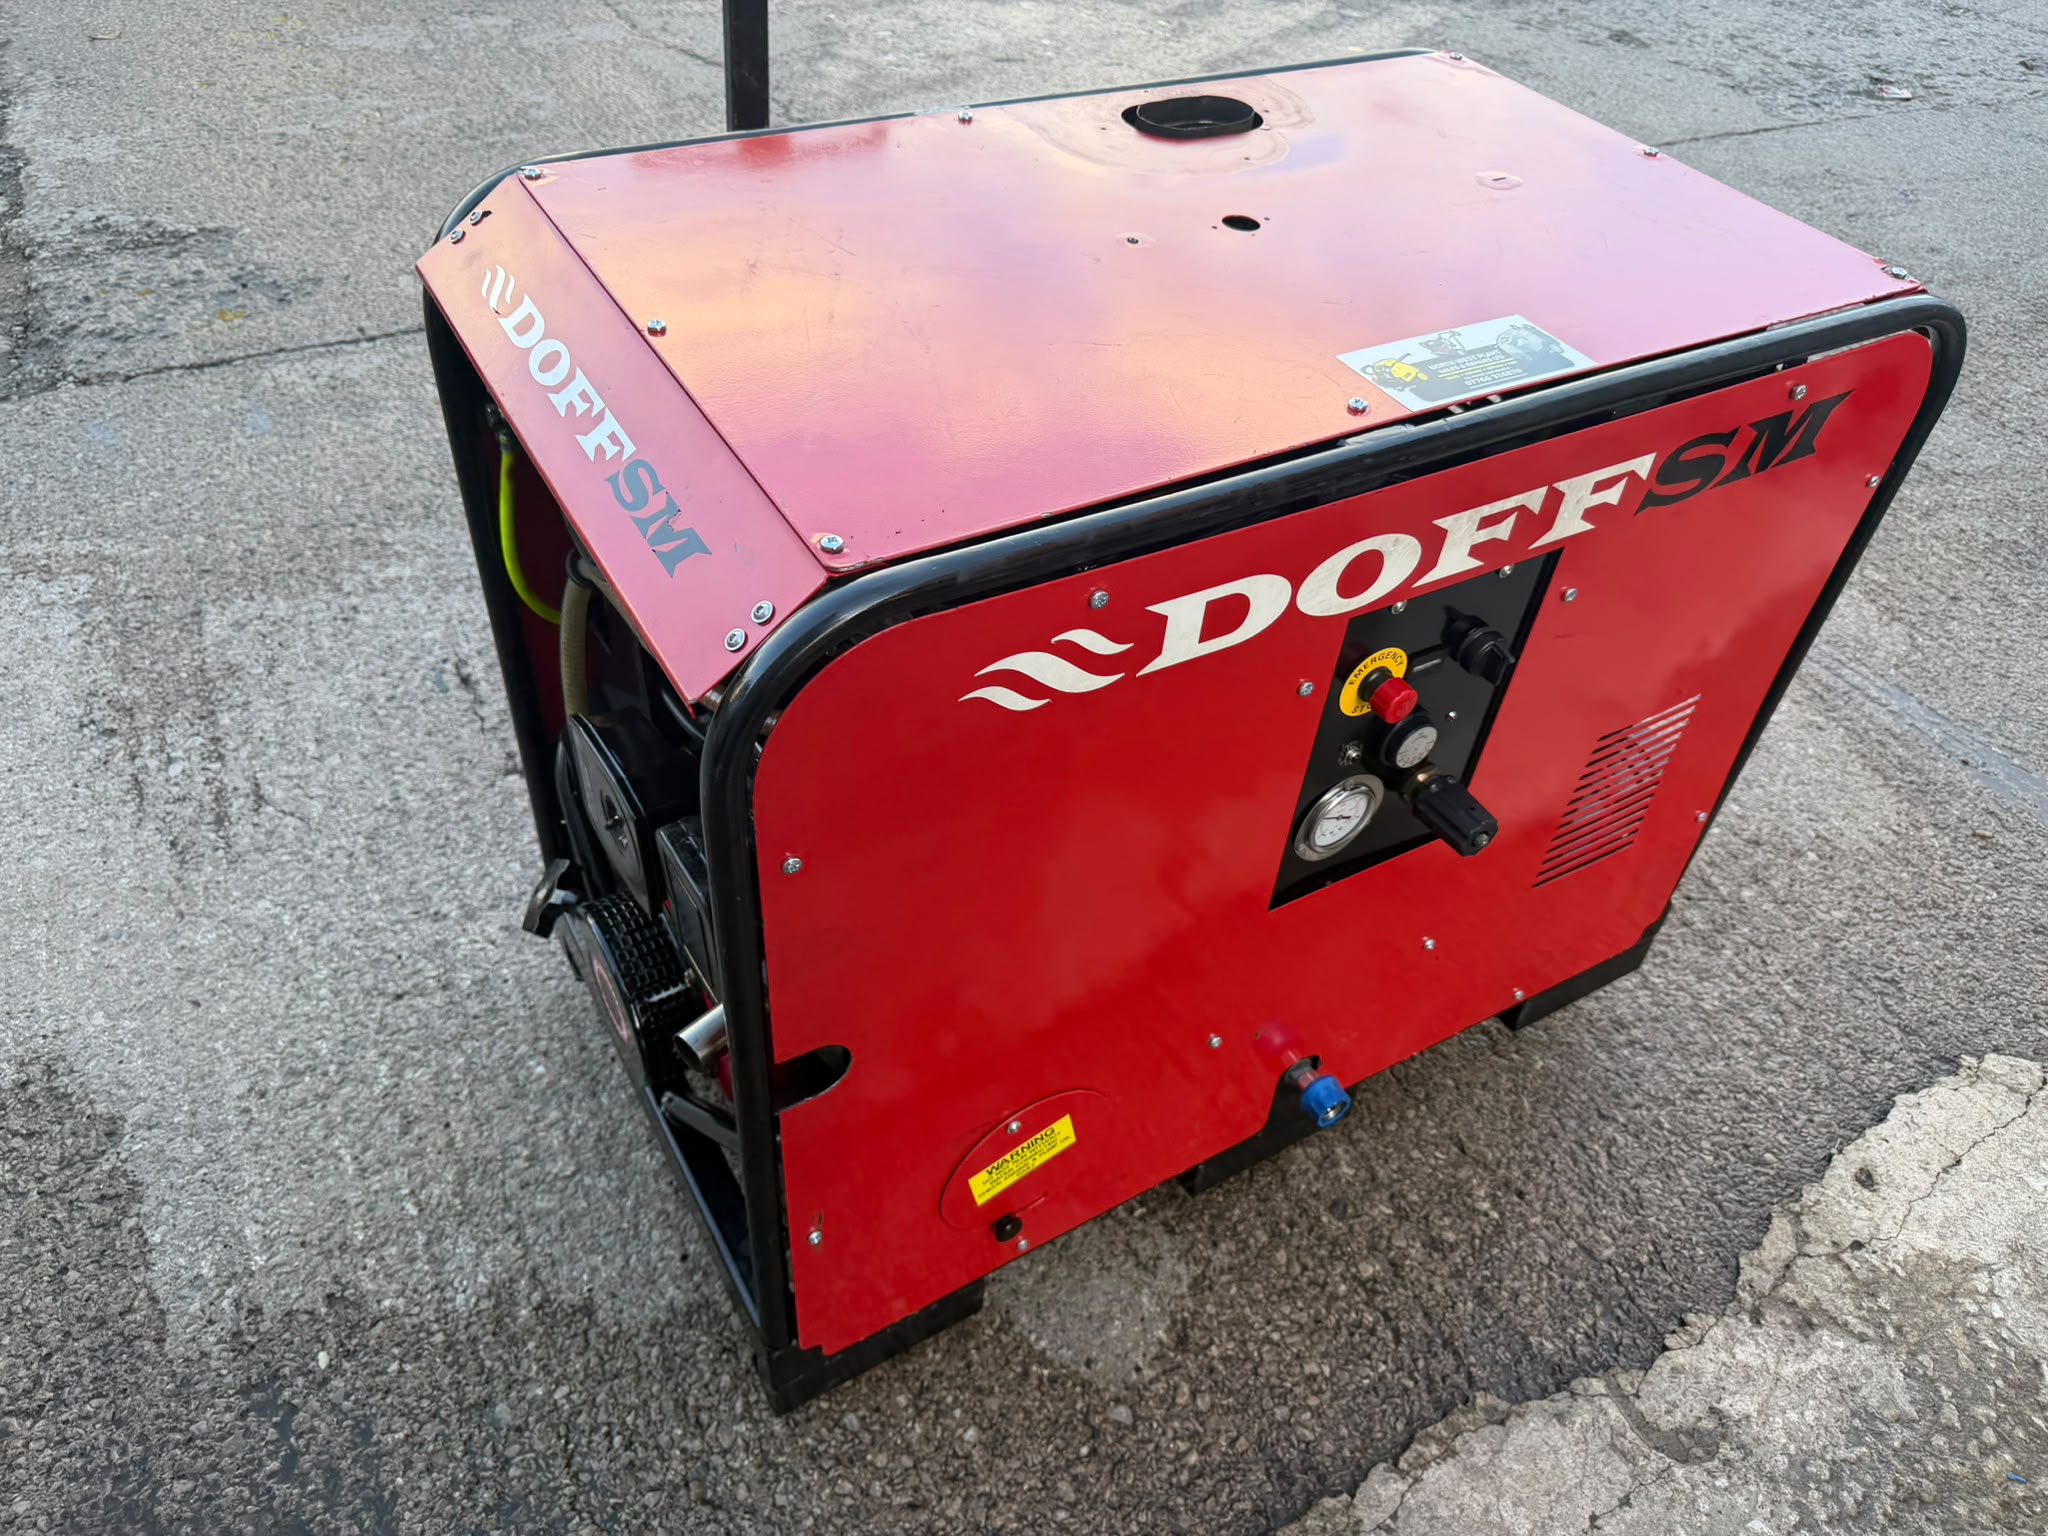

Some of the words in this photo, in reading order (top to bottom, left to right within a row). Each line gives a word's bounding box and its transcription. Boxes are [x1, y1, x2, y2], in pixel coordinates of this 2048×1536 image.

[1429, 361, 1456, 370] NORTH
[1457, 354, 1477, 364] WEST
[1478, 350, 1500, 359] PLANT
[1348, 651, 1404, 686] EMERGENCY
[986, 1127, 1055, 1175] WARNING
